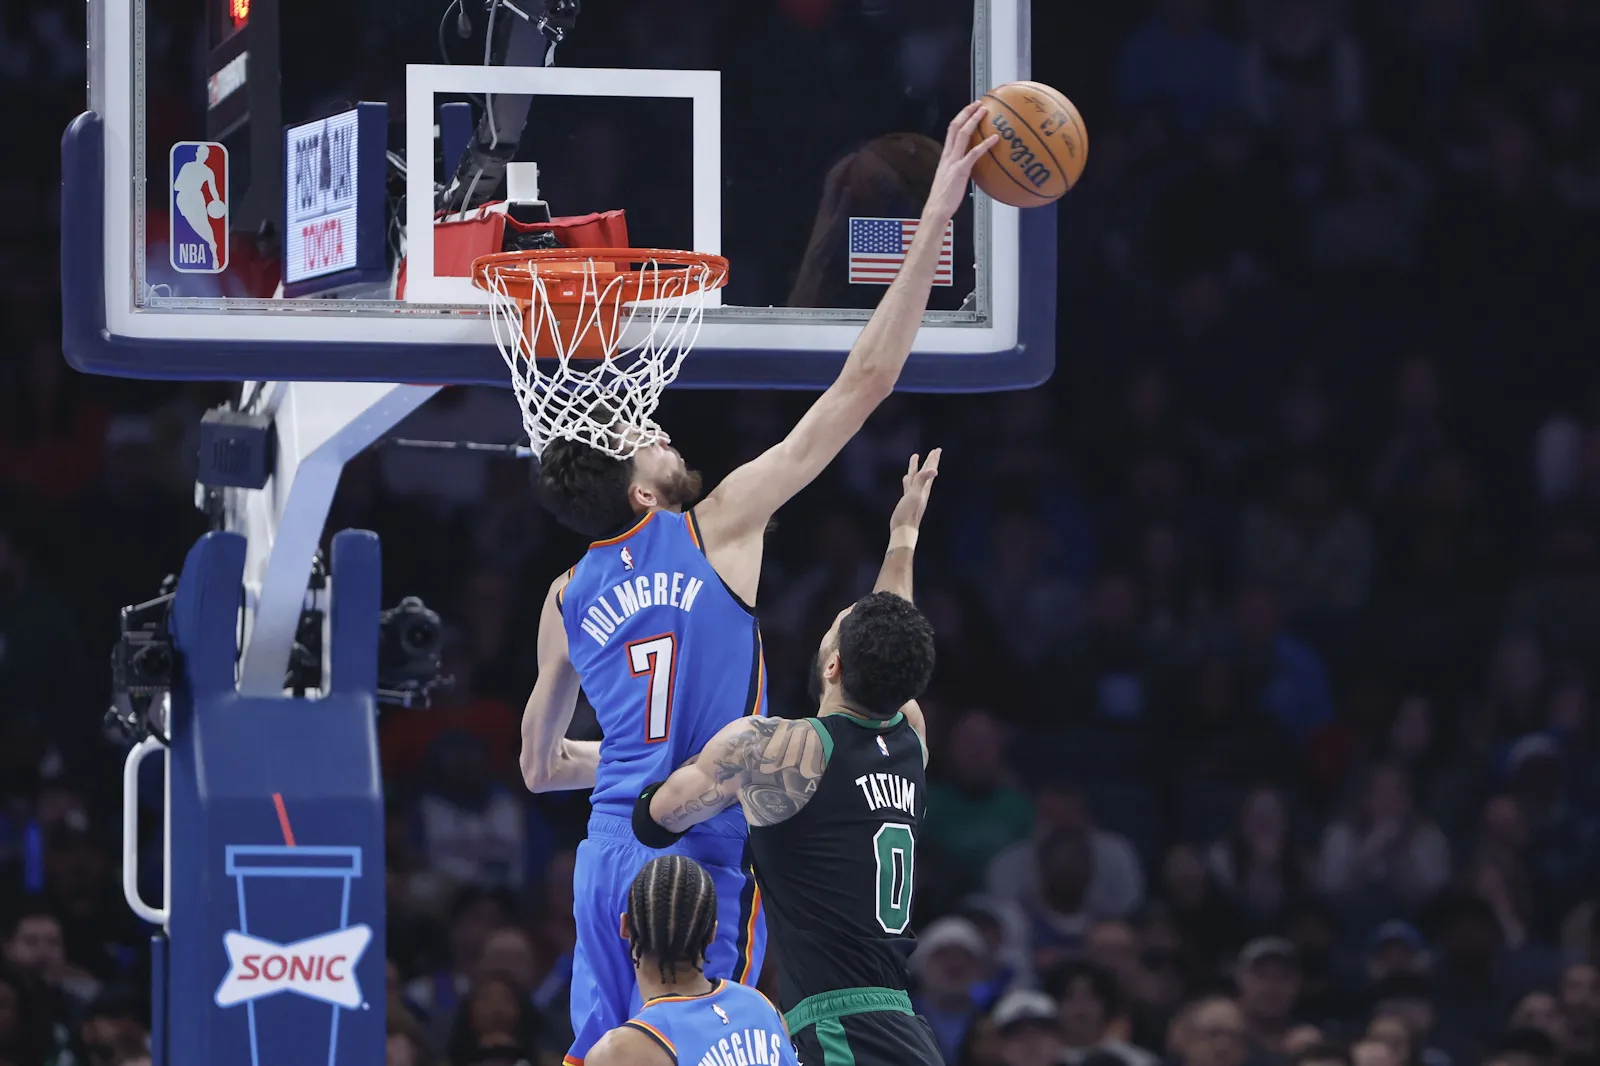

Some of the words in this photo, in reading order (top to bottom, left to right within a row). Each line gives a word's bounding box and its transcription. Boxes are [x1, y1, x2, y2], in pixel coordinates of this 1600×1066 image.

[295, 133, 319, 213] POST
[992, 113, 1051, 188] Wilson
[180, 243, 206, 264] NBA
[302, 218, 344, 272] TOYOTA
[581, 571, 703, 647] HOLMGREN
[624, 631, 678, 744] 7
[855, 772, 915, 817] TATUM
[873, 822, 914, 935] 0
[236, 955, 347, 981] SONIC
